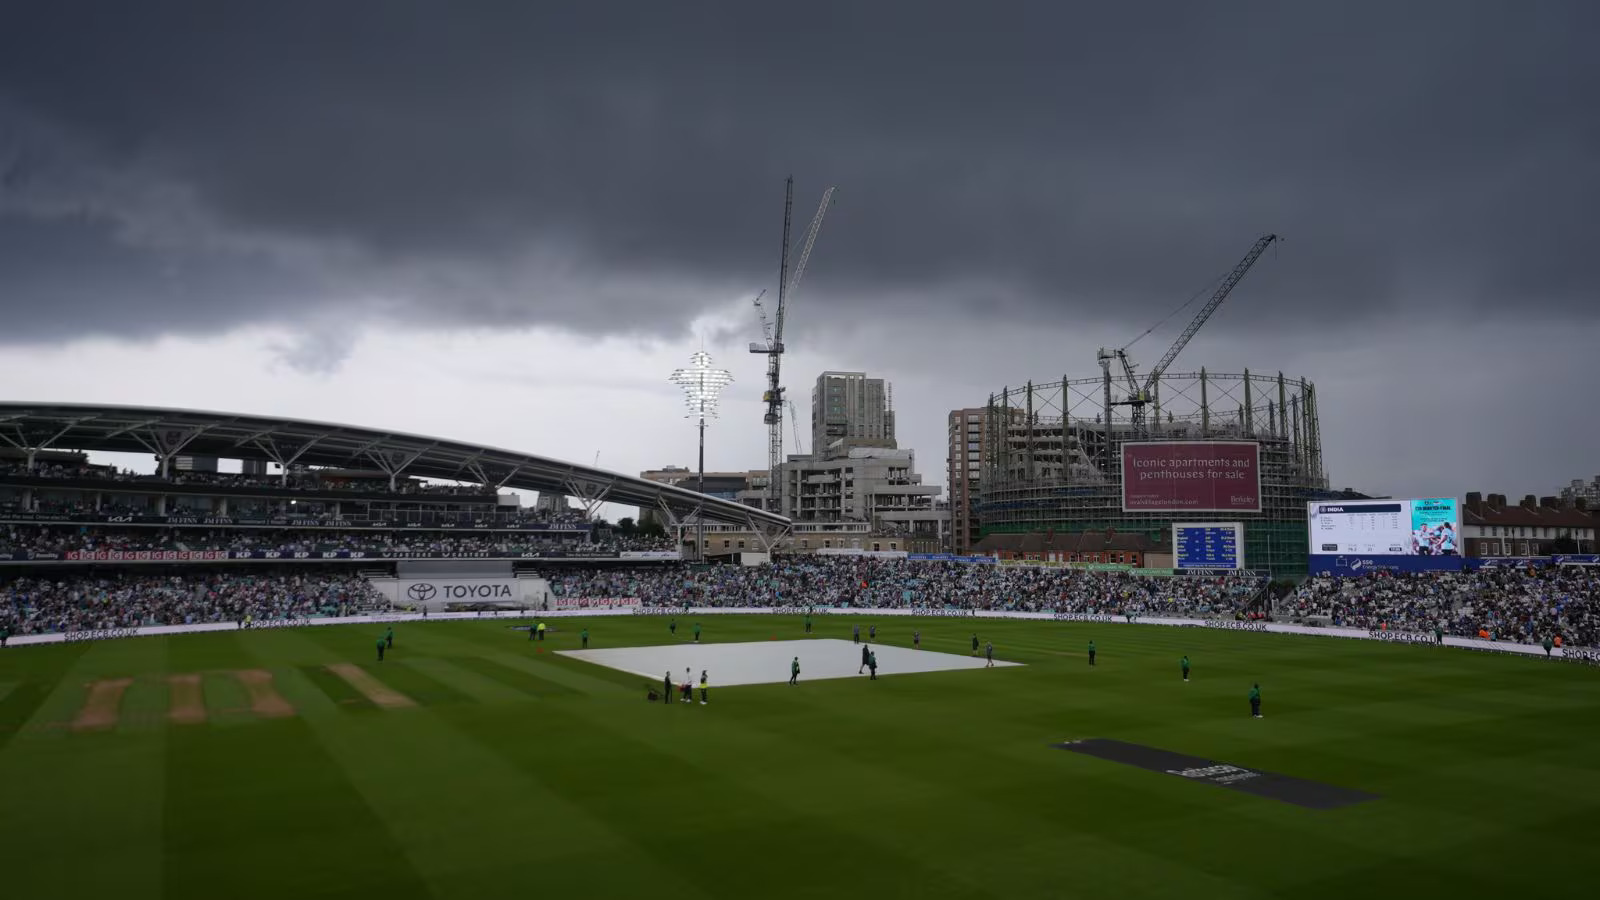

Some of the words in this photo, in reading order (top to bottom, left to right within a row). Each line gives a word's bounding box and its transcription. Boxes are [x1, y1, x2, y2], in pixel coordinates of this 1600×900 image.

[1133, 456, 1166, 468] Iconic
[1169, 458, 1230, 471] apartments
[1232, 457, 1250, 468] and
[1140, 469, 1205, 481] penthouses
[1207, 469, 1223, 479] for
[1225, 469, 1245, 479] sale
[67, 551, 78, 559] IG
[443, 584, 512, 598] TOYOTA
[911, 609, 968, 617] SHOP.ECB.CO.UK
[1053, 613, 1113, 622] SHOP.ECB.CO.UK
[1204, 620, 1267, 631] SHOP.ECB.CO.UK
[64, 628, 139, 641] SHOP.ECB.CO.UK
[1368, 631, 1437, 645] SHOP.ECB.CO.U
